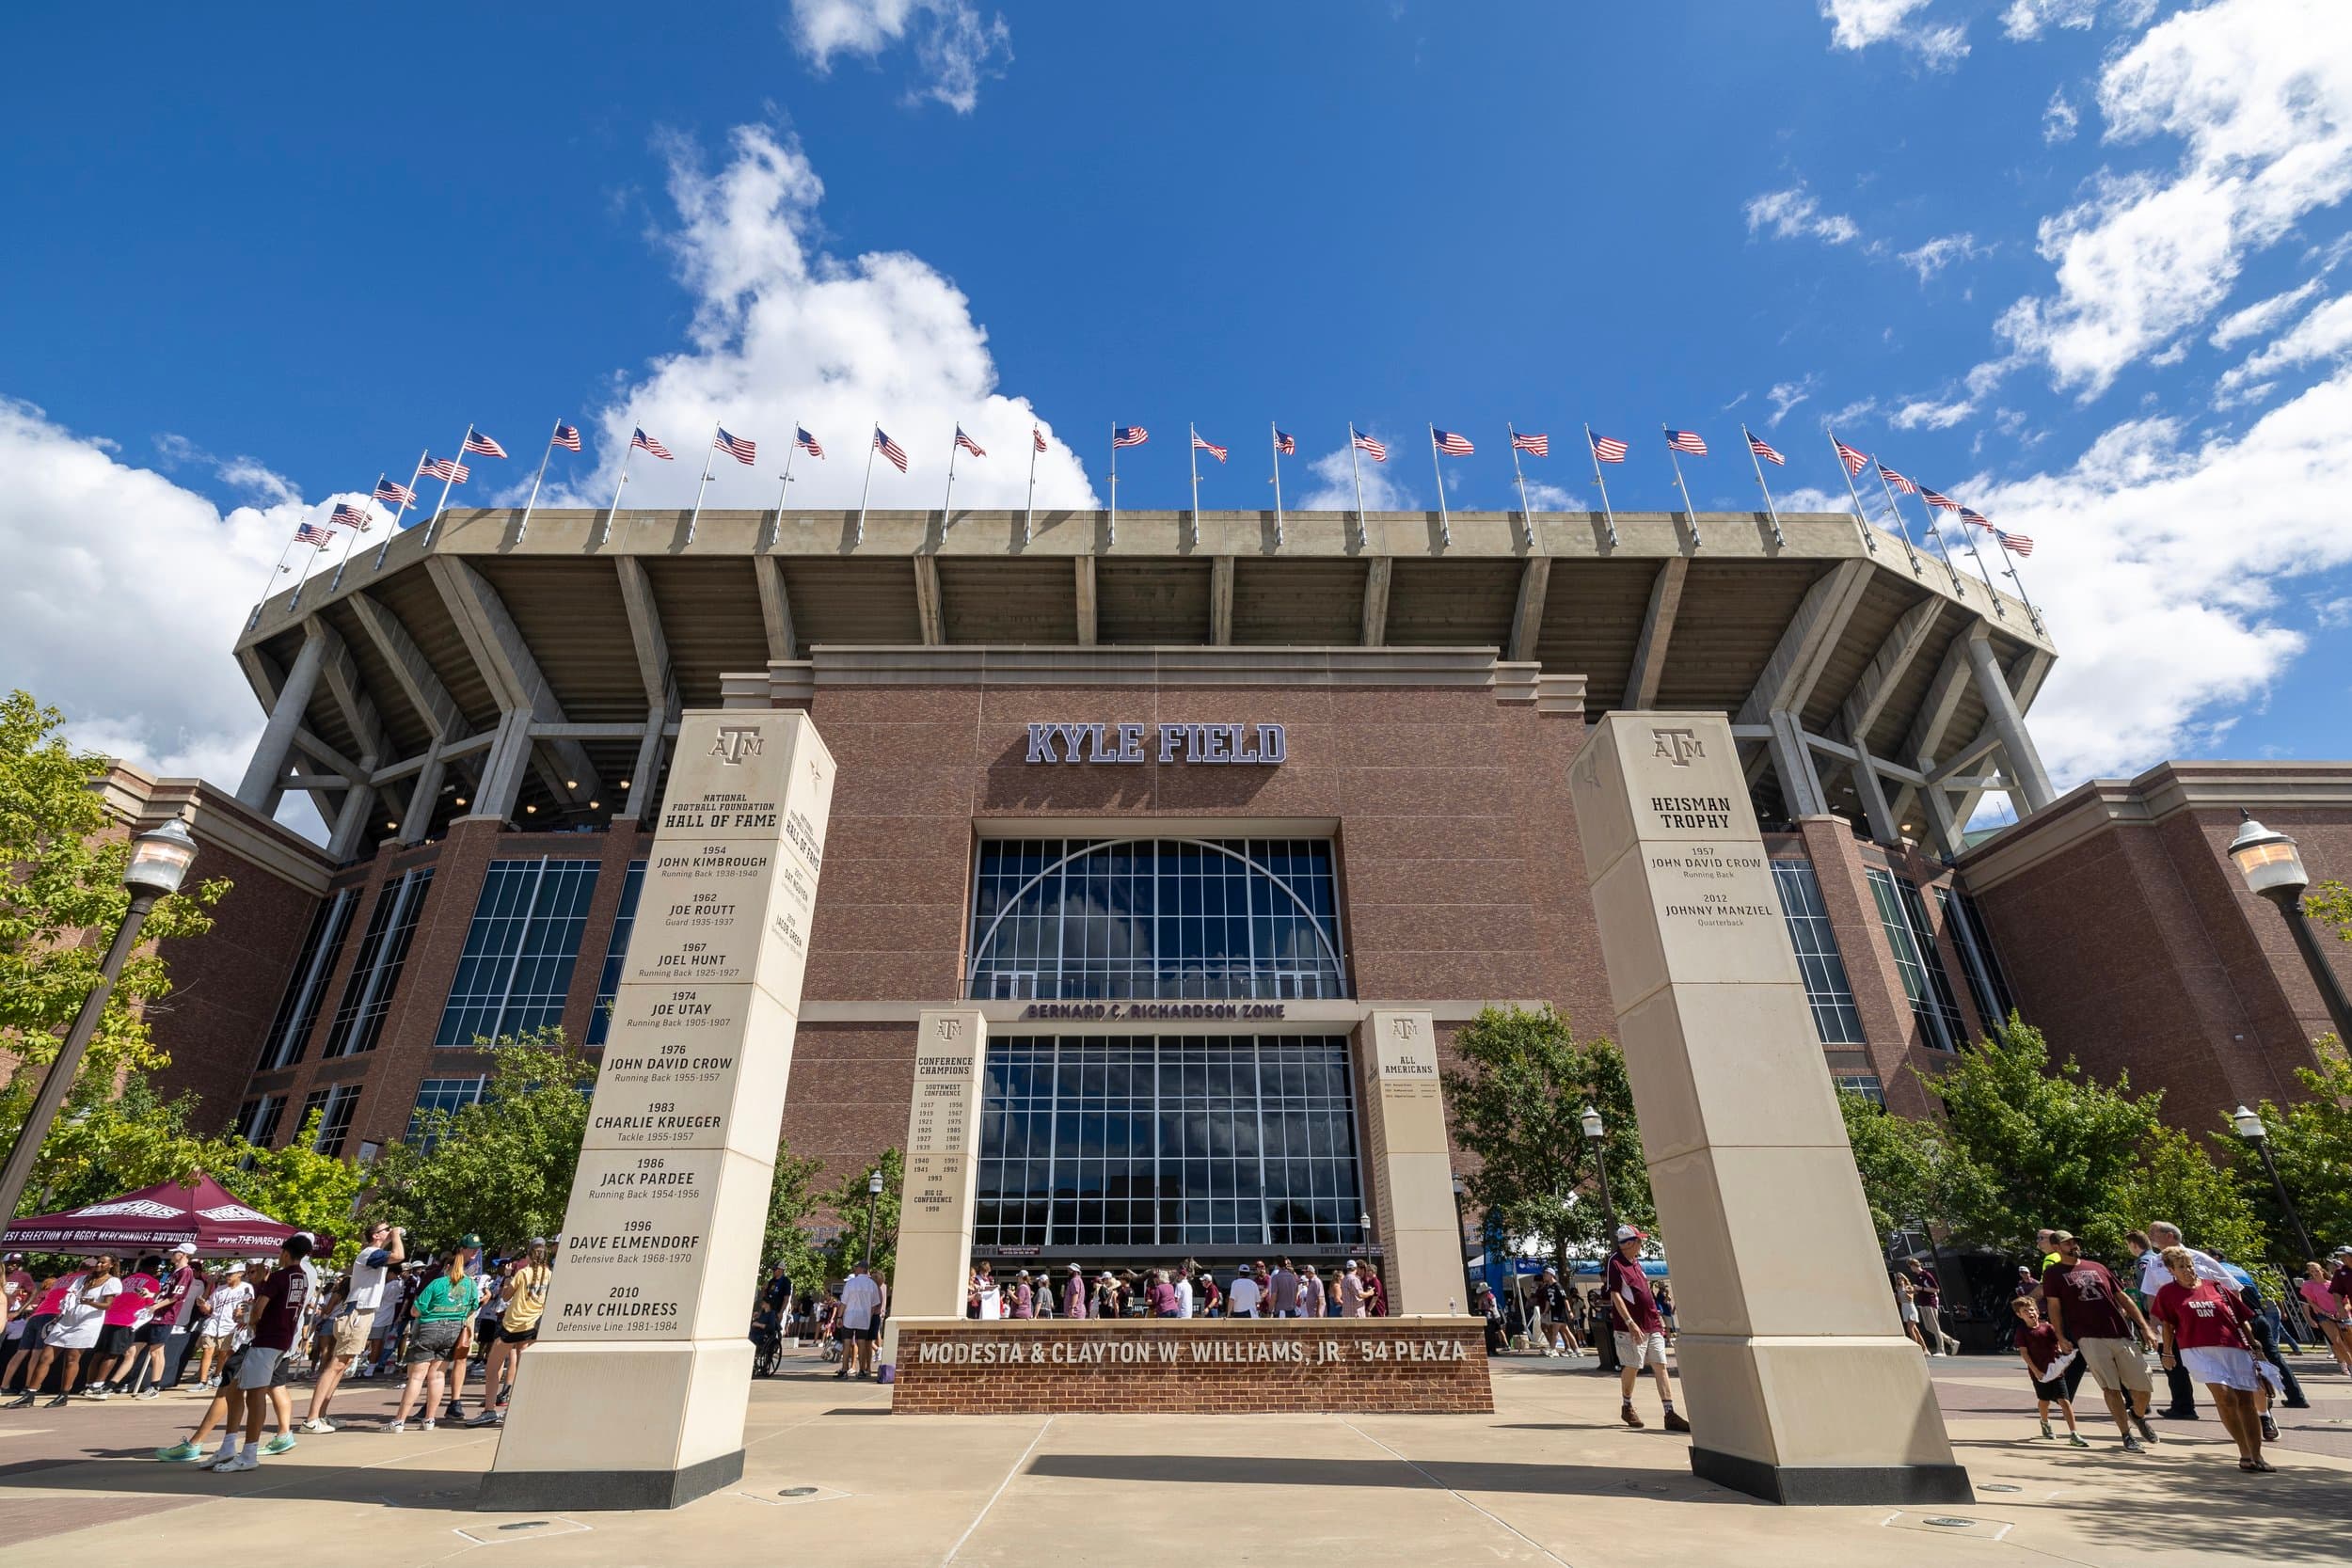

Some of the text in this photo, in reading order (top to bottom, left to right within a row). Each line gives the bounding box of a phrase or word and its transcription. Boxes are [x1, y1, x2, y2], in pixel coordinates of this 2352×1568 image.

[1025, 722, 1287, 765] KYLE FIELD
[703, 794, 747, 802] NATIONAL
[672, 803, 775, 812] FOOTBALL FOUNDATION
[1651, 797, 1731, 812] HEISMAN
[664, 814, 777, 828] HALL OF FAME
[1660, 815, 1730, 829] TROPHY
[703, 847, 726, 855] 1954
[786, 819, 820, 873] HALL OF FAME
[1692, 847, 1715, 856] 1957
[657, 857, 768, 868] JOHN KIMBROUGH
[1651, 858, 1762, 868] JOHN DAVID CROW
[661, 870, 692, 879] Running
[1683, 871, 1715, 879] Running
[692, 894, 717, 902] 1962
[1703, 895, 1728, 903] 2012
[669, 905, 736, 916] JOE ROUTT
[1665, 906, 1773, 916] JOHNNY MANZIEL
[1697, 918, 1745, 927] Quarterback
[683, 943, 707, 952] 1967
[657, 955, 726, 967] JOEL HUNT
[639, 969, 671, 978] Running
[672, 991, 696, 1001] 1974
[651, 1004, 712, 1016] JOE UTAY
[1026, 1004, 1105, 1019] BERNARD
[1130, 1004, 1238, 1019] RICHARDSON
[1243, 1004, 1286, 1019] ZONE
[627, 1019, 660, 1028] Running
[660, 1045, 686, 1054] 1976
[608, 1058, 733, 1071] JOHN DAVID CROW
[918, 1056, 973, 1066] CONFERENCE
[1400, 1055, 1416, 1065] ALL
[919, 1066, 970, 1075] CHAMPIONS
[614, 1073, 721, 1083] Running Back 1955-1957
[647, 1102, 675, 1112] 1983
[595, 1116, 723, 1129] CHARLIE KRUEGER
[617, 1132, 694, 1142] Tackle 1955-1957
[637, 1158, 664, 1168] 1986
[600, 1172, 695, 1187] JACK PARDEE
[588, 1189, 700, 1200] Running Back 1954-1956
[624, 1221, 652, 1231] 1996
[3, 1230, 198, 1243] EST SELECTION OF AGGIE MERCHANDISE ANYWHERE!
[569, 1235, 700, 1249] DAVE ELMENDORF
[570, 1253, 692, 1264] Defensive Back 1968-1970
[172, 1285, 185, 1294] 12
[609, 1287, 640, 1298] 2010
[563, 1302, 678, 1317] RAY CHILDRESS
[2188, 1301, 2216, 1309] GAME
[2197, 1308, 2214, 1317] DAY
[556, 1321, 678, 1332] Defensive Line 1981-1984
[918, 1341, 1024, 1364] MODESTA
[1030, 1342, 1045, 1364] &
[1051, 1341, 1151, 1364] CLAYTON
[1190, 1341, 1311, 1366] WILLIAMS,
[1316, 1340, 1346, 1366] JR.
[1354, 1340, 1389, 1361] '54
[1394, 1340, 1468, 1362] PLAZA
